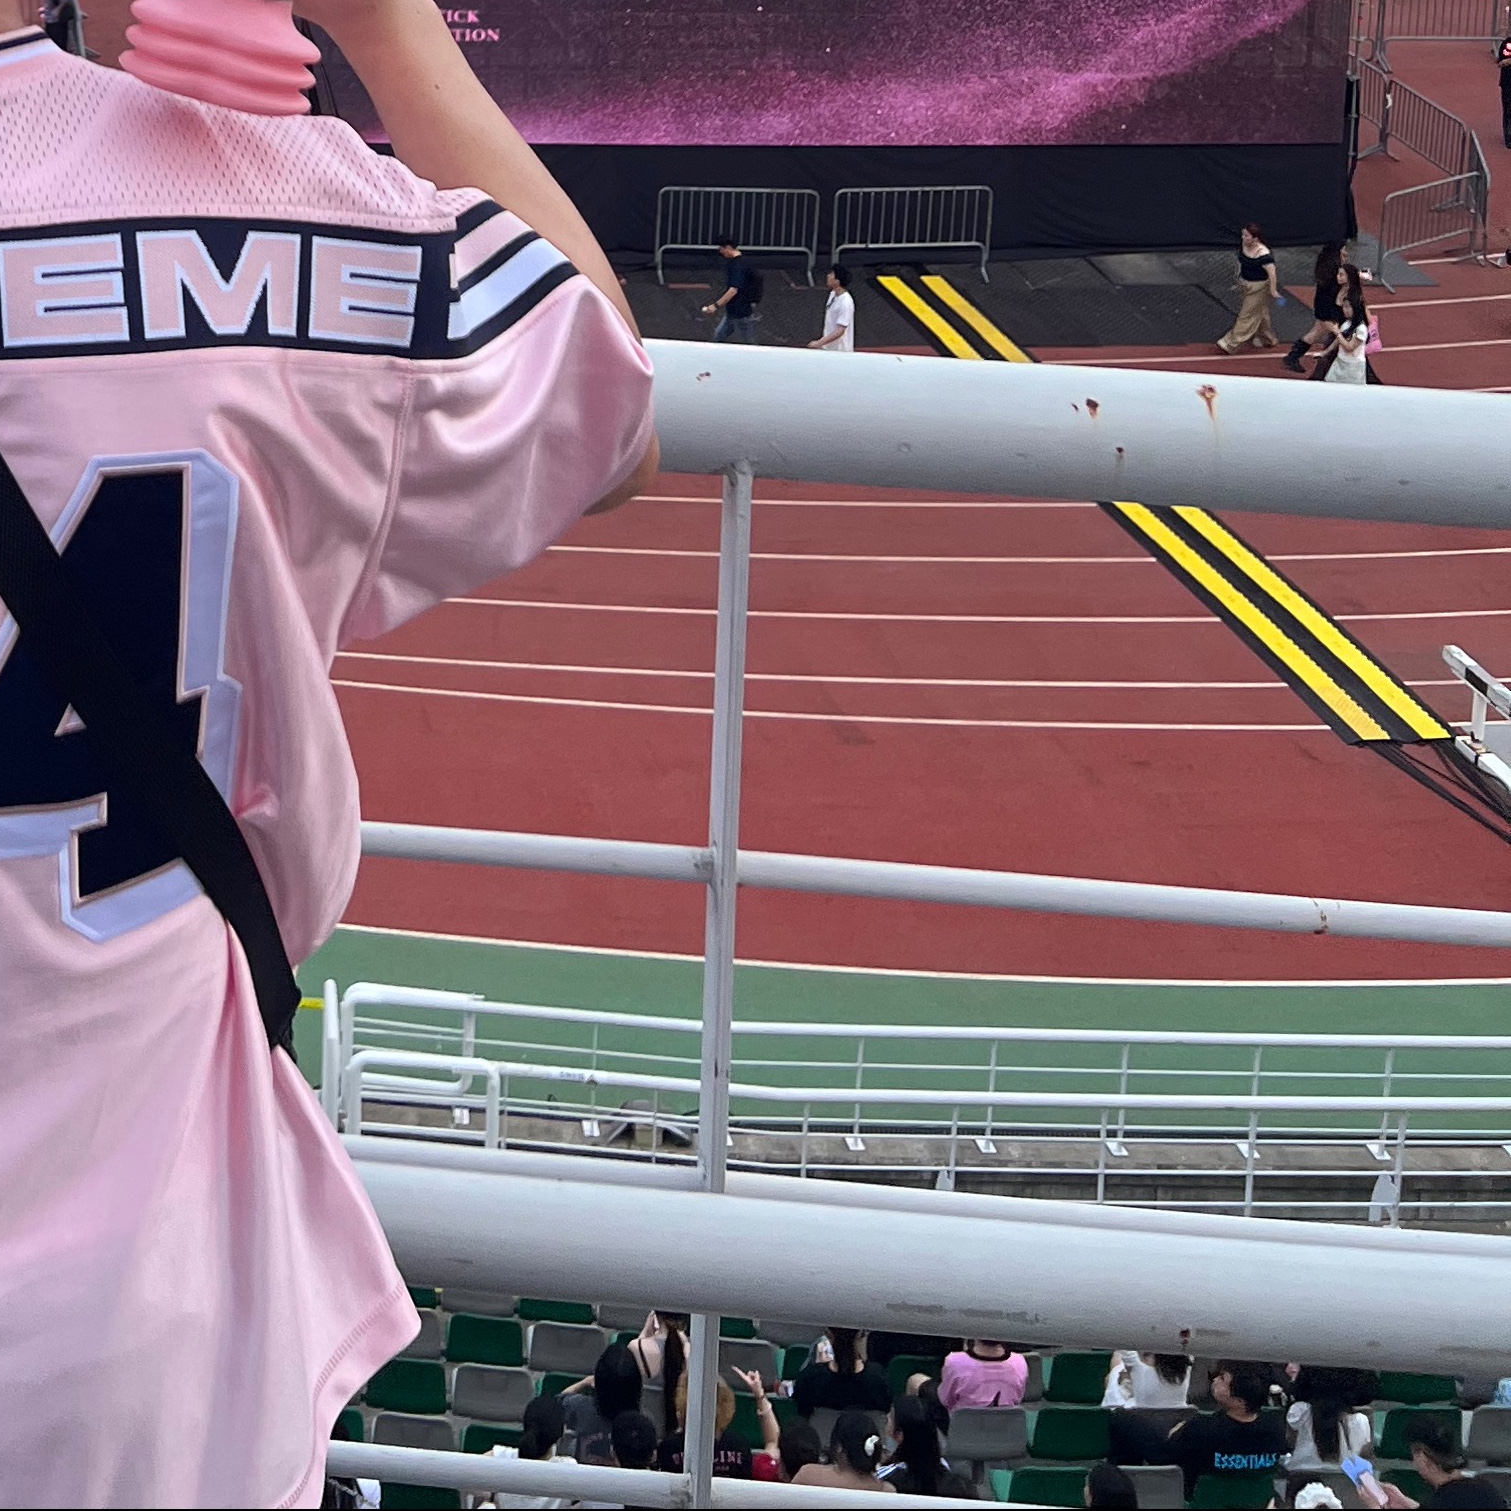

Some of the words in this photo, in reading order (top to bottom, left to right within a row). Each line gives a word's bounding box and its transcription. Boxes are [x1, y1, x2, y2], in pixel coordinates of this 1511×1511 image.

[441, 9, 479, 23] ICK
[451, 28, 501, 42] TION
[1213, 1452, 1278, 1469] ESSENTIALS
